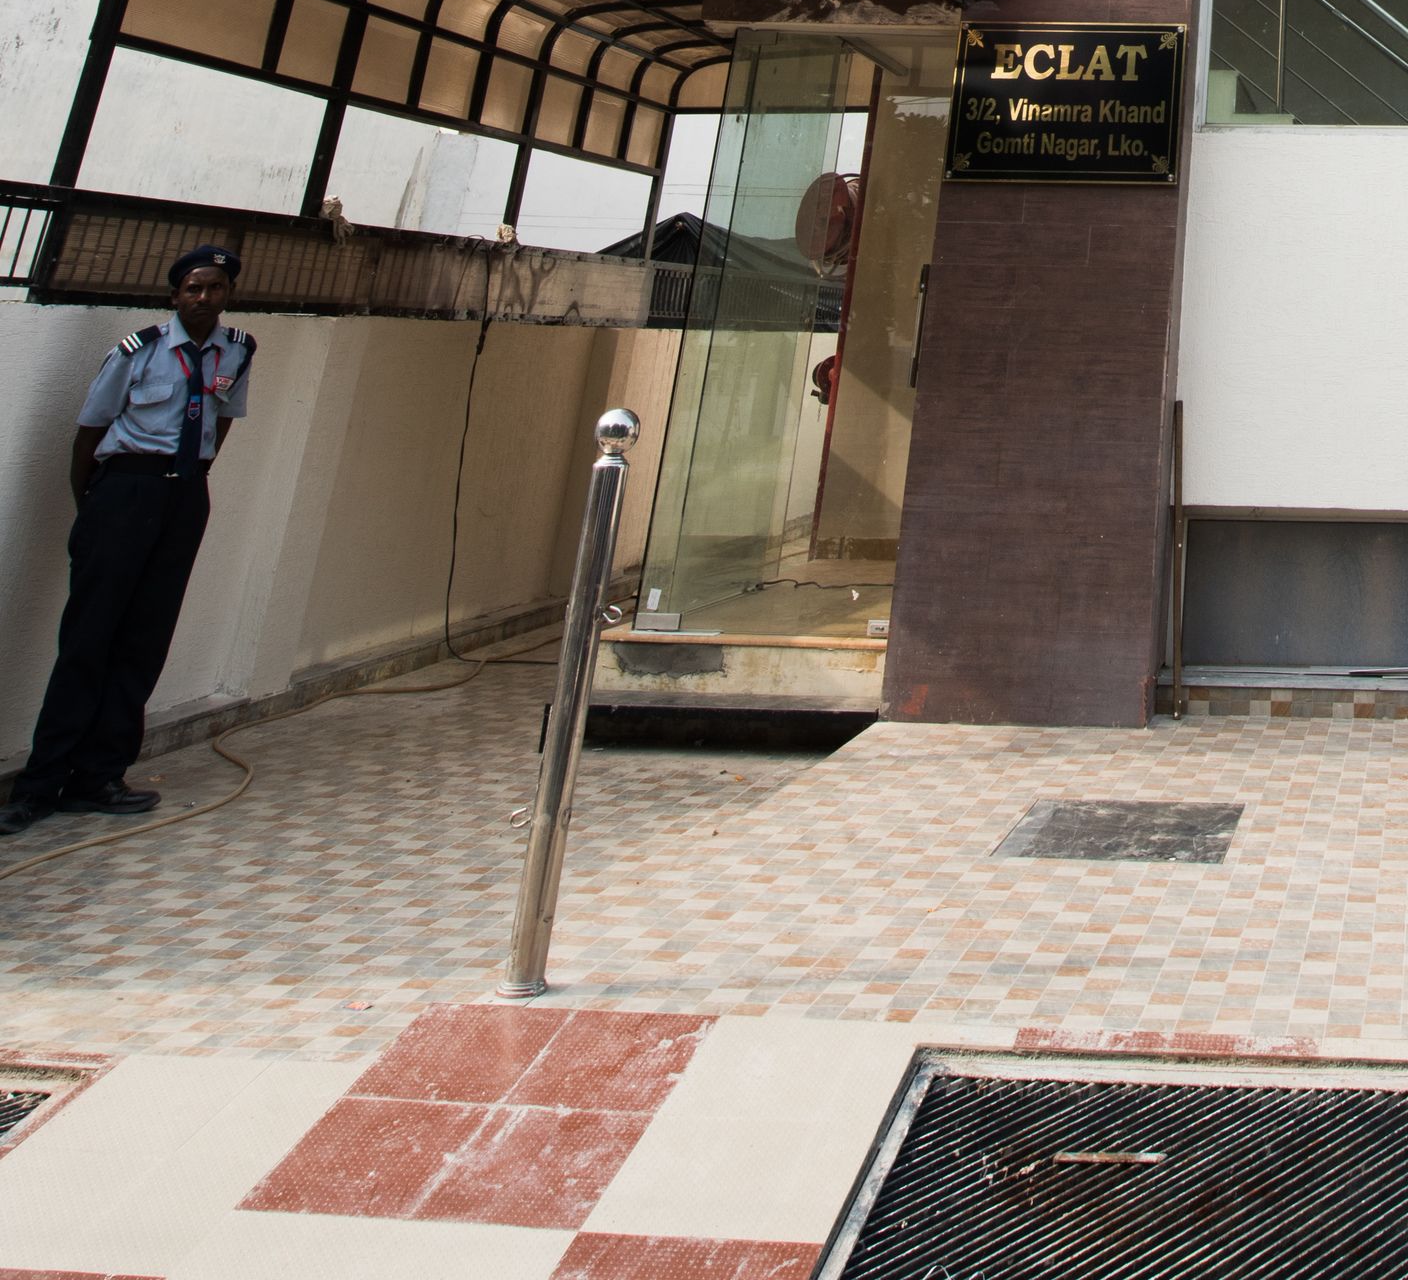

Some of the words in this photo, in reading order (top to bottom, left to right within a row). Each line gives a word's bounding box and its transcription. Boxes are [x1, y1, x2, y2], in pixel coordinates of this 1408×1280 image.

[990, 43, 1148, 81] ECLAT
[965, 97, 1001, 126] 3/2,
[1008, 98, 1092, 123] Vinamra
[1099, 99, 1166, 124] Khand
[976, 131, 1035, 155] Gomti
[1040, 133, 1101, 161] Nagar,
[1108, 134, 1149, 157] Lko.
